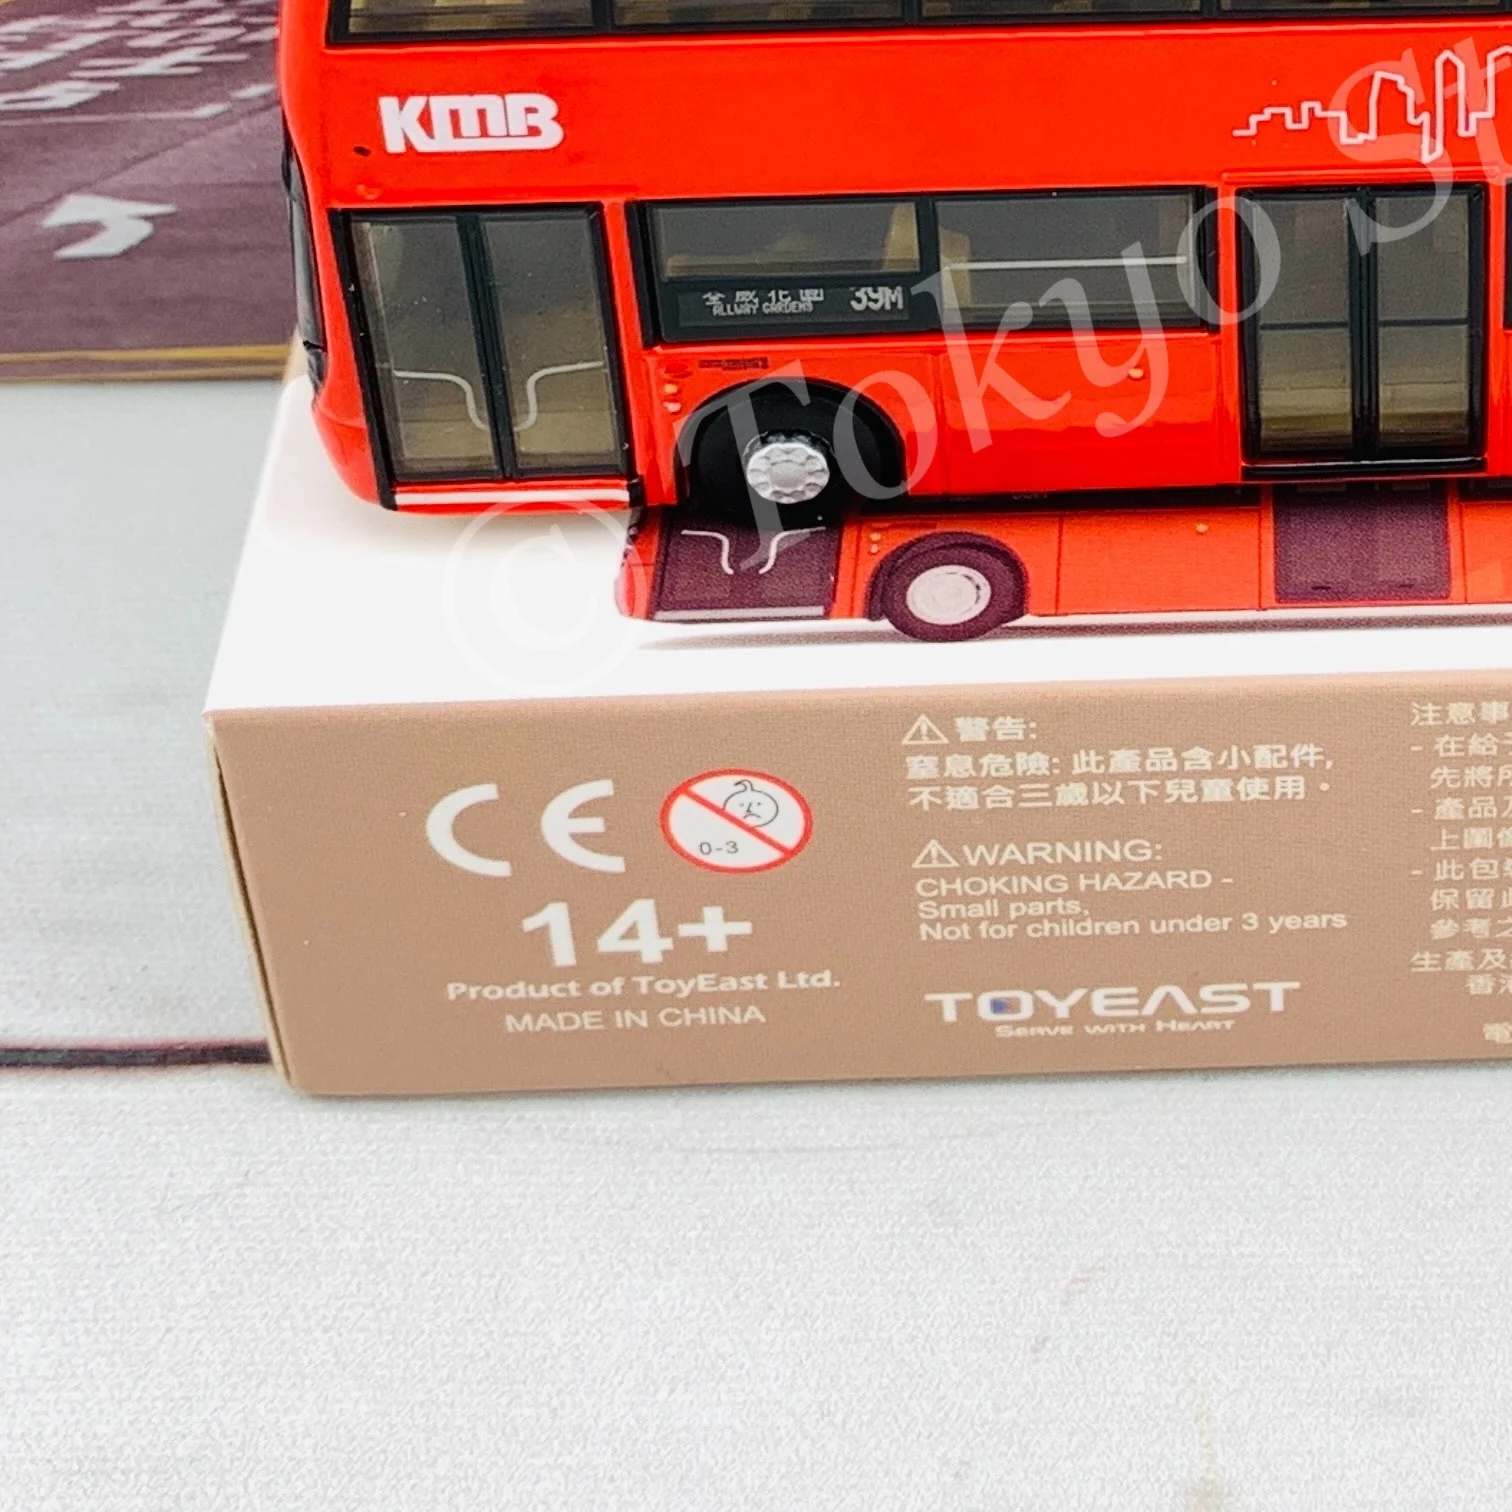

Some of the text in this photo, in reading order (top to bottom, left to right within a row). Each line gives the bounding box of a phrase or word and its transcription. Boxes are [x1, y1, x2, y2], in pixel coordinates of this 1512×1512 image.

[850, 286, 904, 311] 39M
[955, 716, 1038, 743] 警告:
[699, 840, 739, 856] 0-3
[963, 840, 1163, 867] WARNING:
[915, 874, 1069, 898] CHOKING
[1079, 870, 1213, 892] HAZARD
[918, 900, 1000, 920] Small
[522, 898, 753, 967] 14+
[919, 912, 1348, 941] Not for children under 3 years
[447, 969, 841, 1001] Product of ToyEast Ltd.
[924, 982, 1300, 1023] TOYEAST
[505, 1005, 766, 1033] MADE IN CHINA
